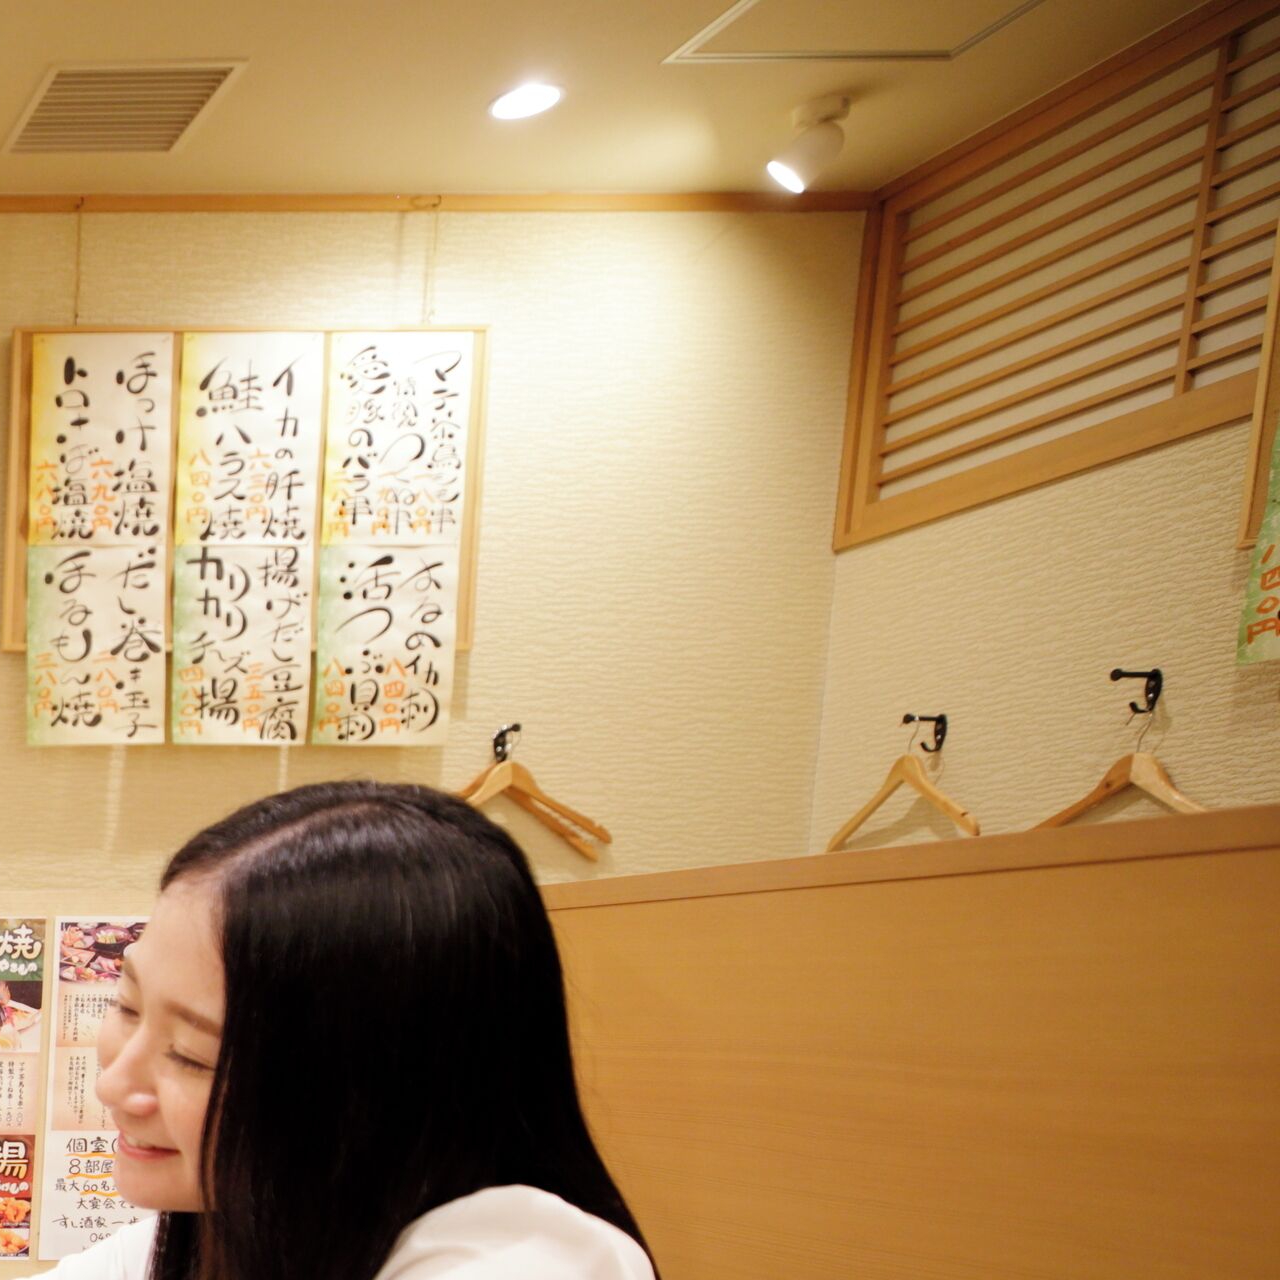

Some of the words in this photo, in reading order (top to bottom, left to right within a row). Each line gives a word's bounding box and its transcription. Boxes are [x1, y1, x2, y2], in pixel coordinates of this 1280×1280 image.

[196, 357, 264, 541] 鮭ハラス焼
